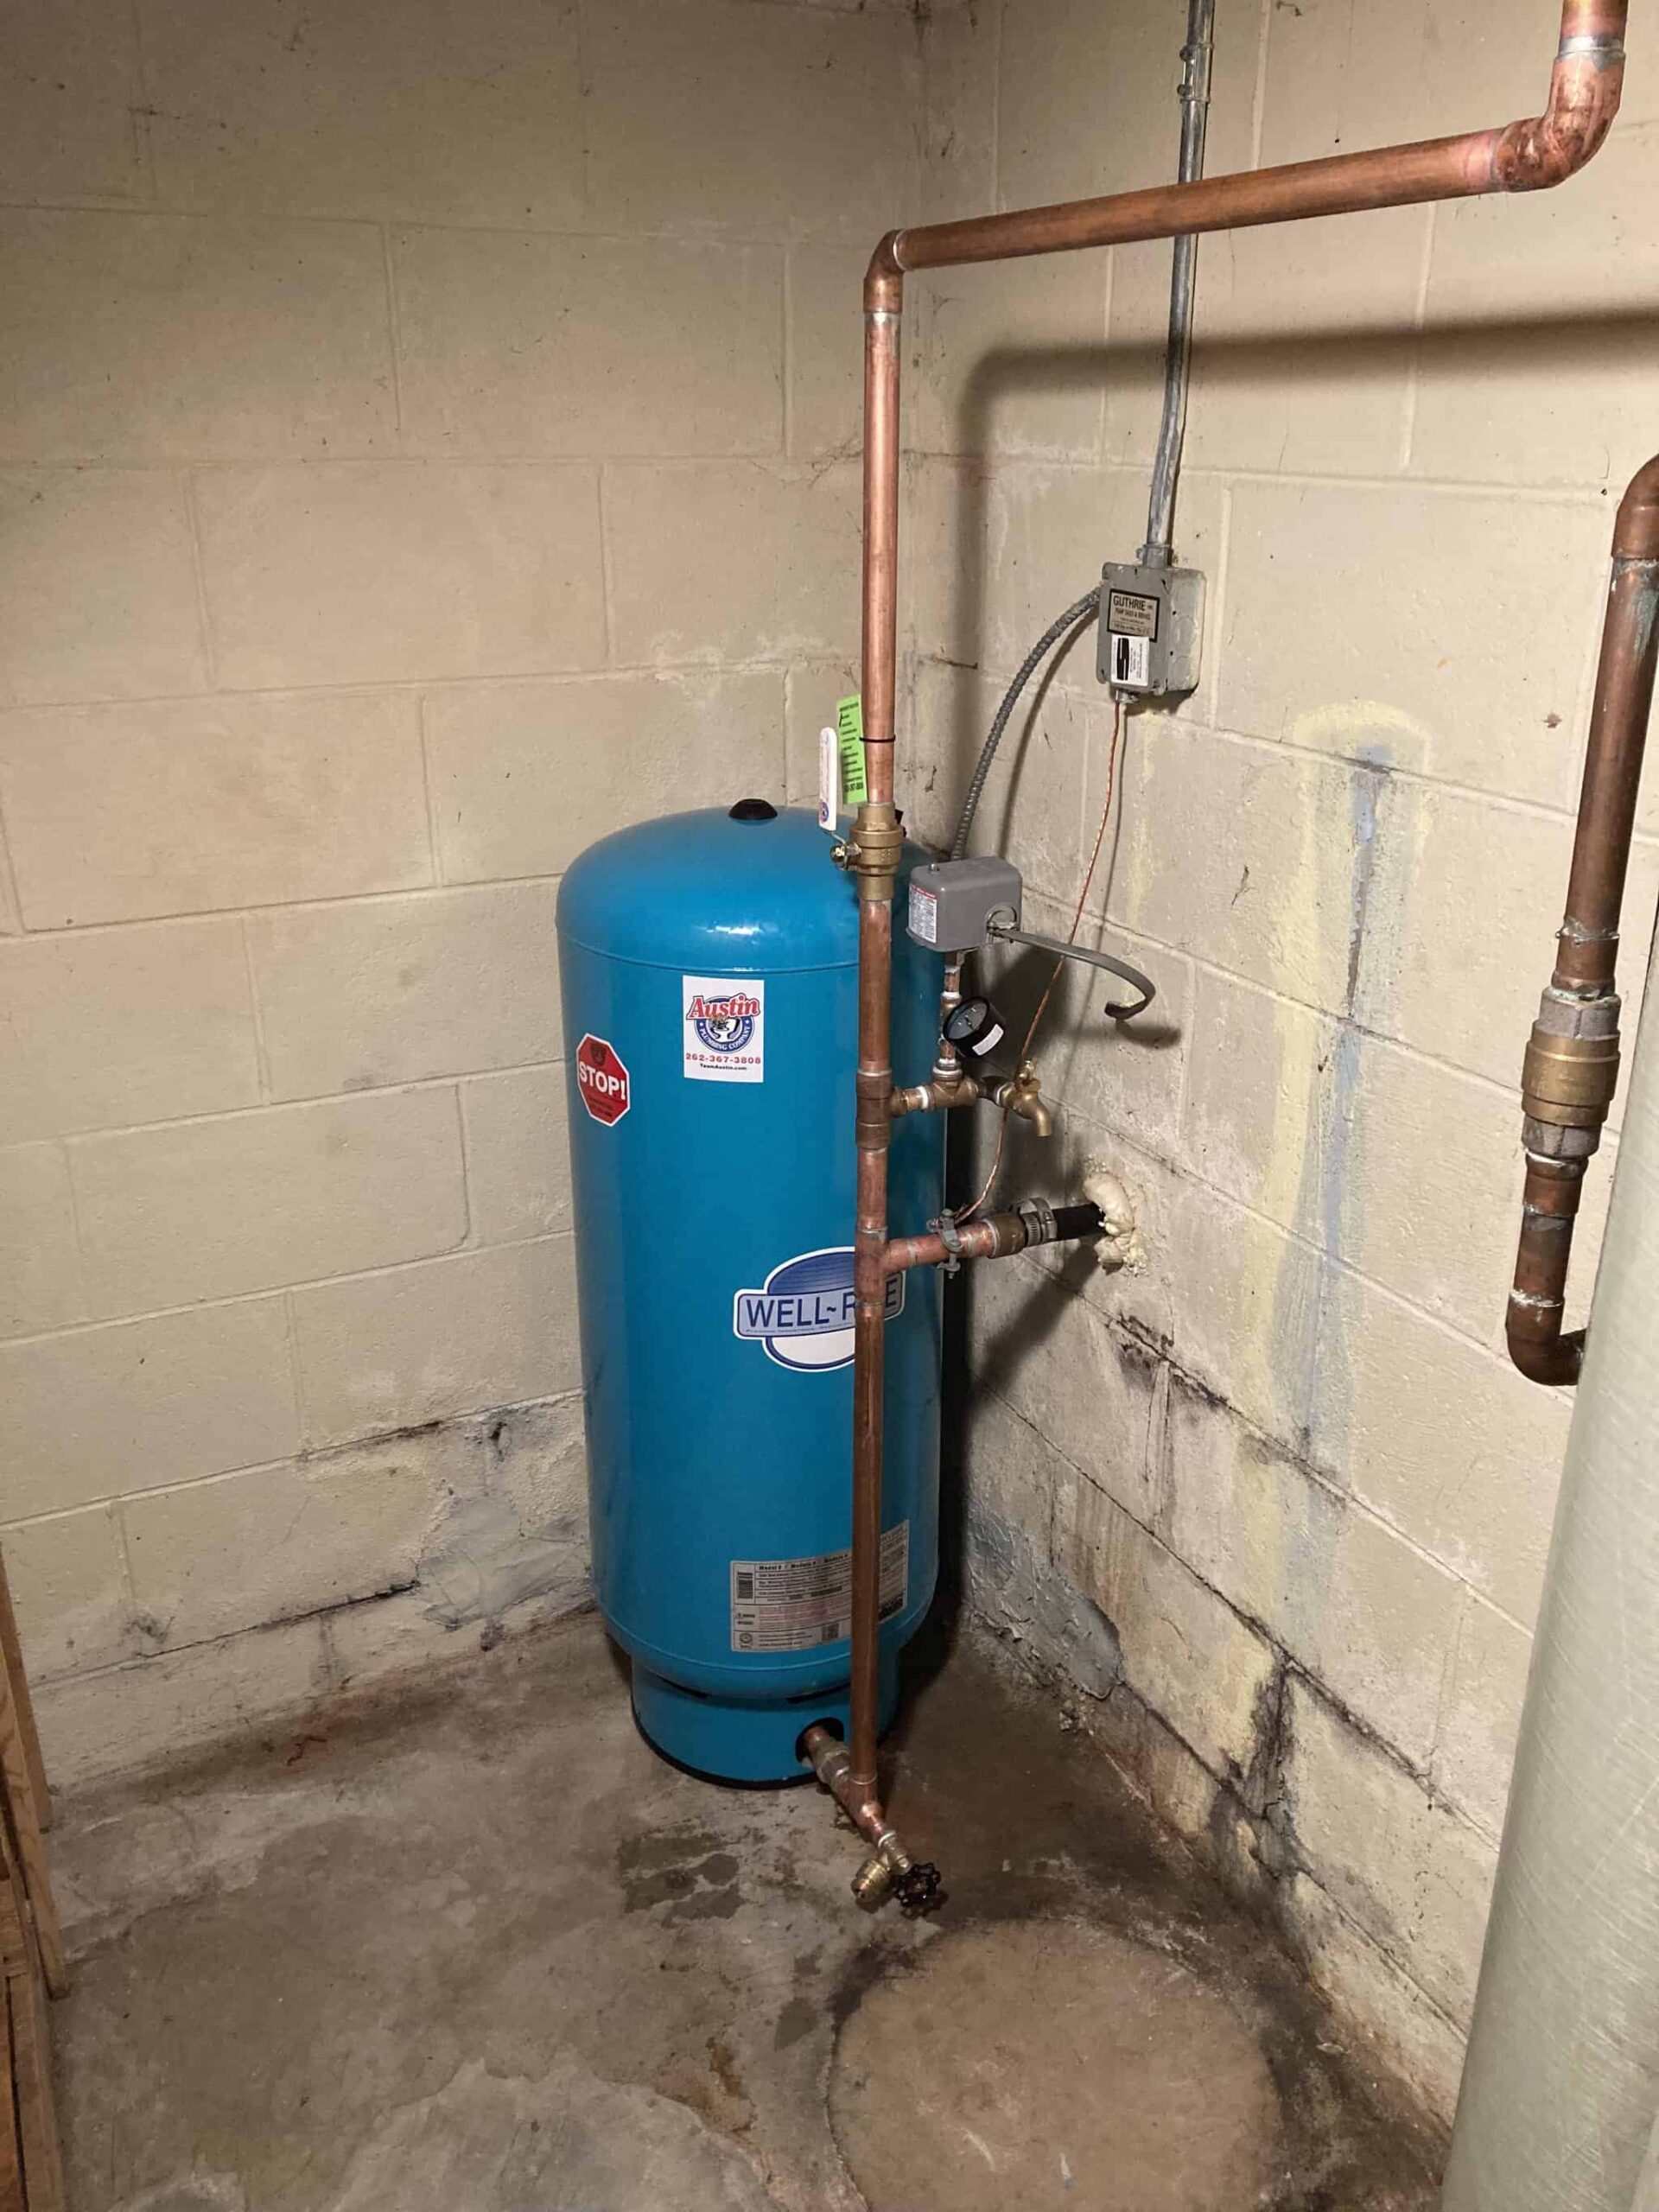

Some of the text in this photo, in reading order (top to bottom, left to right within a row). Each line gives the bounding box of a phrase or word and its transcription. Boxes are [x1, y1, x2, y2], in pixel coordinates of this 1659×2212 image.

[1114, 595, 1146, 611] GUTHRIE
[687, 994, 760, 1020] Austin
[686, 1052, 761, 1065] 262-367-3808
[579, 1061, 626, 1100] STOP!
